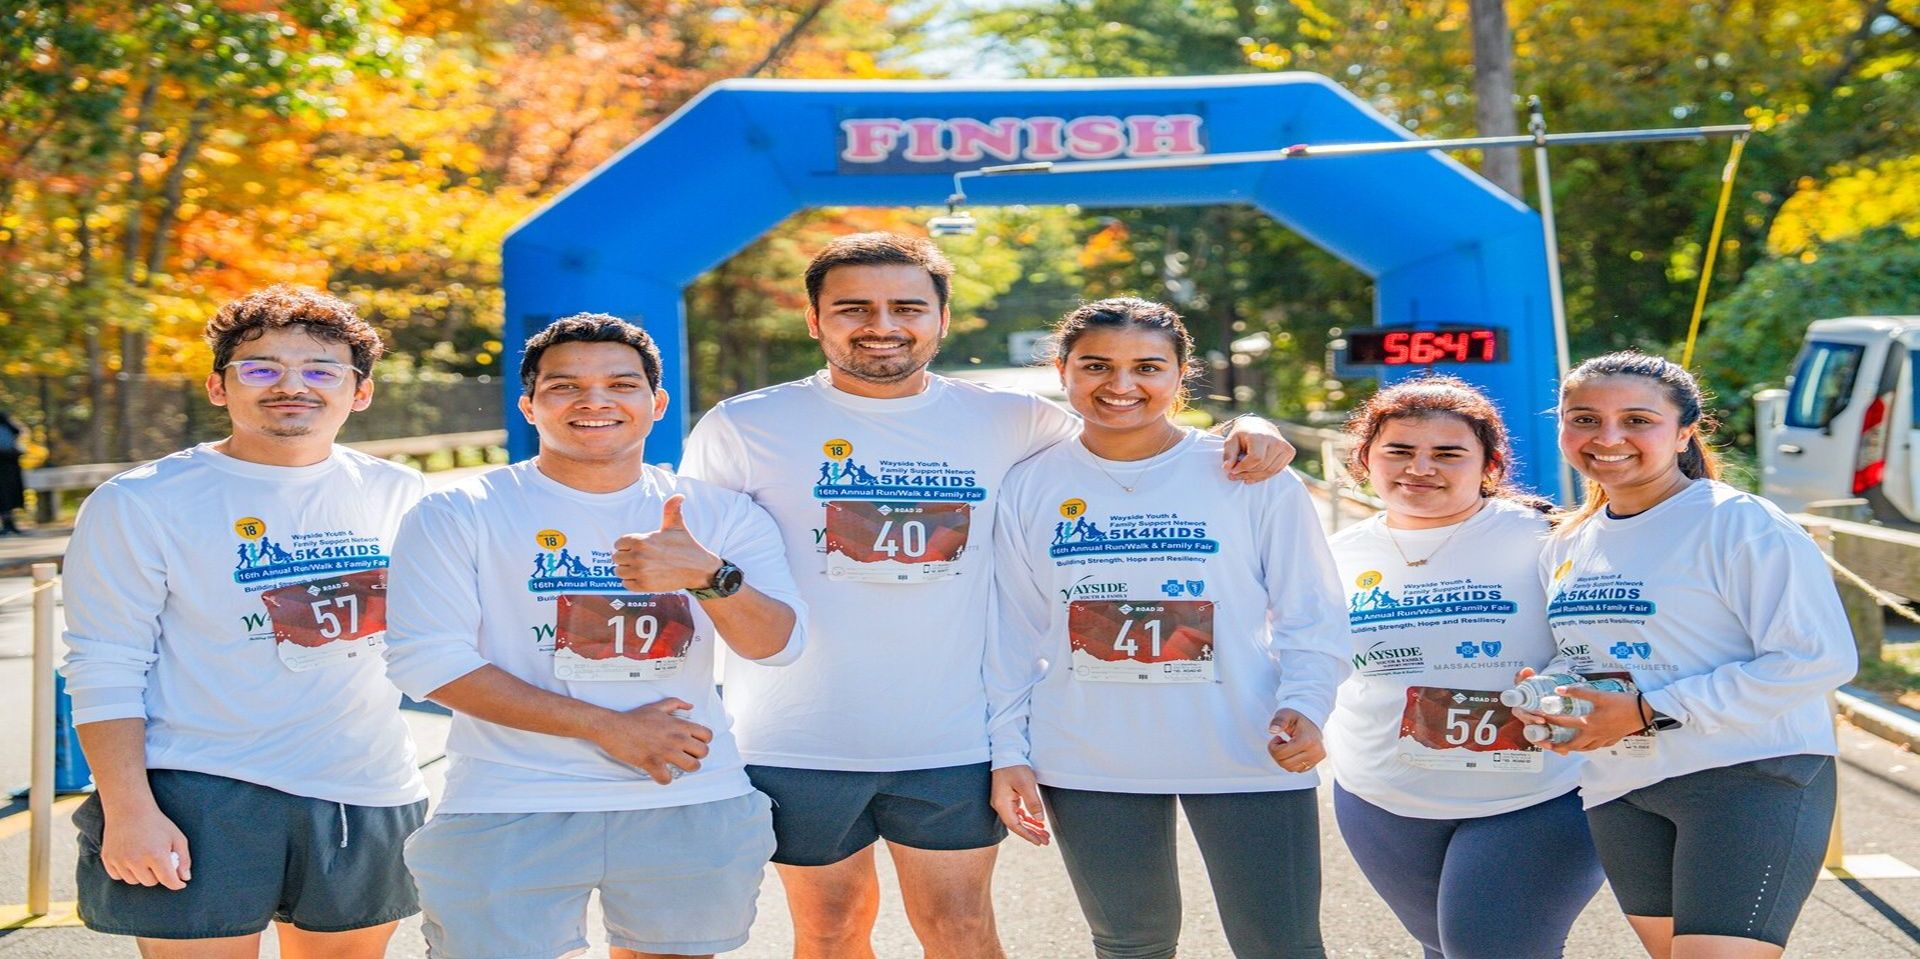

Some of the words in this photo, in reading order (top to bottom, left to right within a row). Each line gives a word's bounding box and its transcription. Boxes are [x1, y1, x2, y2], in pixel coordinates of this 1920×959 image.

[841, 115, 1202, 162] FINISH
[1383, 331, 1496, 364] 56:47
[831, 447, 843, 455] 18
[880, 460, 914, 468] Wayside
[880, 475, 975, 487] 5K4KIDS
[876, 489, 921, 497] Run/Walk
[934, 491, 964, 499] Family
[1066, 506, 1078, 515] 18
[243, 526, 257, 536] 18
[291, 532, 323, 540] Wayside
[1109, 528, 1206, 539] 5K4KIDS
[545, 537, 556, 547] 18
[873, 521, 926, 557] 40
[296, 545, 380, 561] 5K4KIDS
[1053, 547, 1069, 555] 16th
[1071, 545, 1103, 553] Annual
[1105, 543, 1149, 551] Run/Walk
[1161, 542, 1193, 550] Family
[1056, 559, 1086, 567] Building
[240, 572, 260, 580] 16th
[262, 568, 291, 577] Annual
[294, 562, 334, 573] Run/Walk
[344, 560, 372, 569] Family
[373, 558, 388, 566] Fair
[244, 583, 278, 593] Building
[322, 583, 341, 591] ROAD
[533, 581, 554, 589] 16th
[1431, 585, 1466, 593] Support
[1403, 590, 1502, 606] 5K4KIDS
[1568, 588, 1640, 600] 5K4KIDS
[1364, 612, 1395, 620] Annual
[1397, 608, 1442, 617] Run/Walk
[1456, 604, 1487, 612] Family
[1603, 604, 1627, 612] Family
[311, 594, 358, 639] 57
[1378, 622, 1415, 630] Strength,
[608, 615, 658, 654] 19
[1114, 620, 1160, 657] 41
[1352, 644, 1422, 670] WAYSIDE
[1434, 661, 1525, 670] MASSACHUSETTS
[1445, 708, 1497, 746] 56
